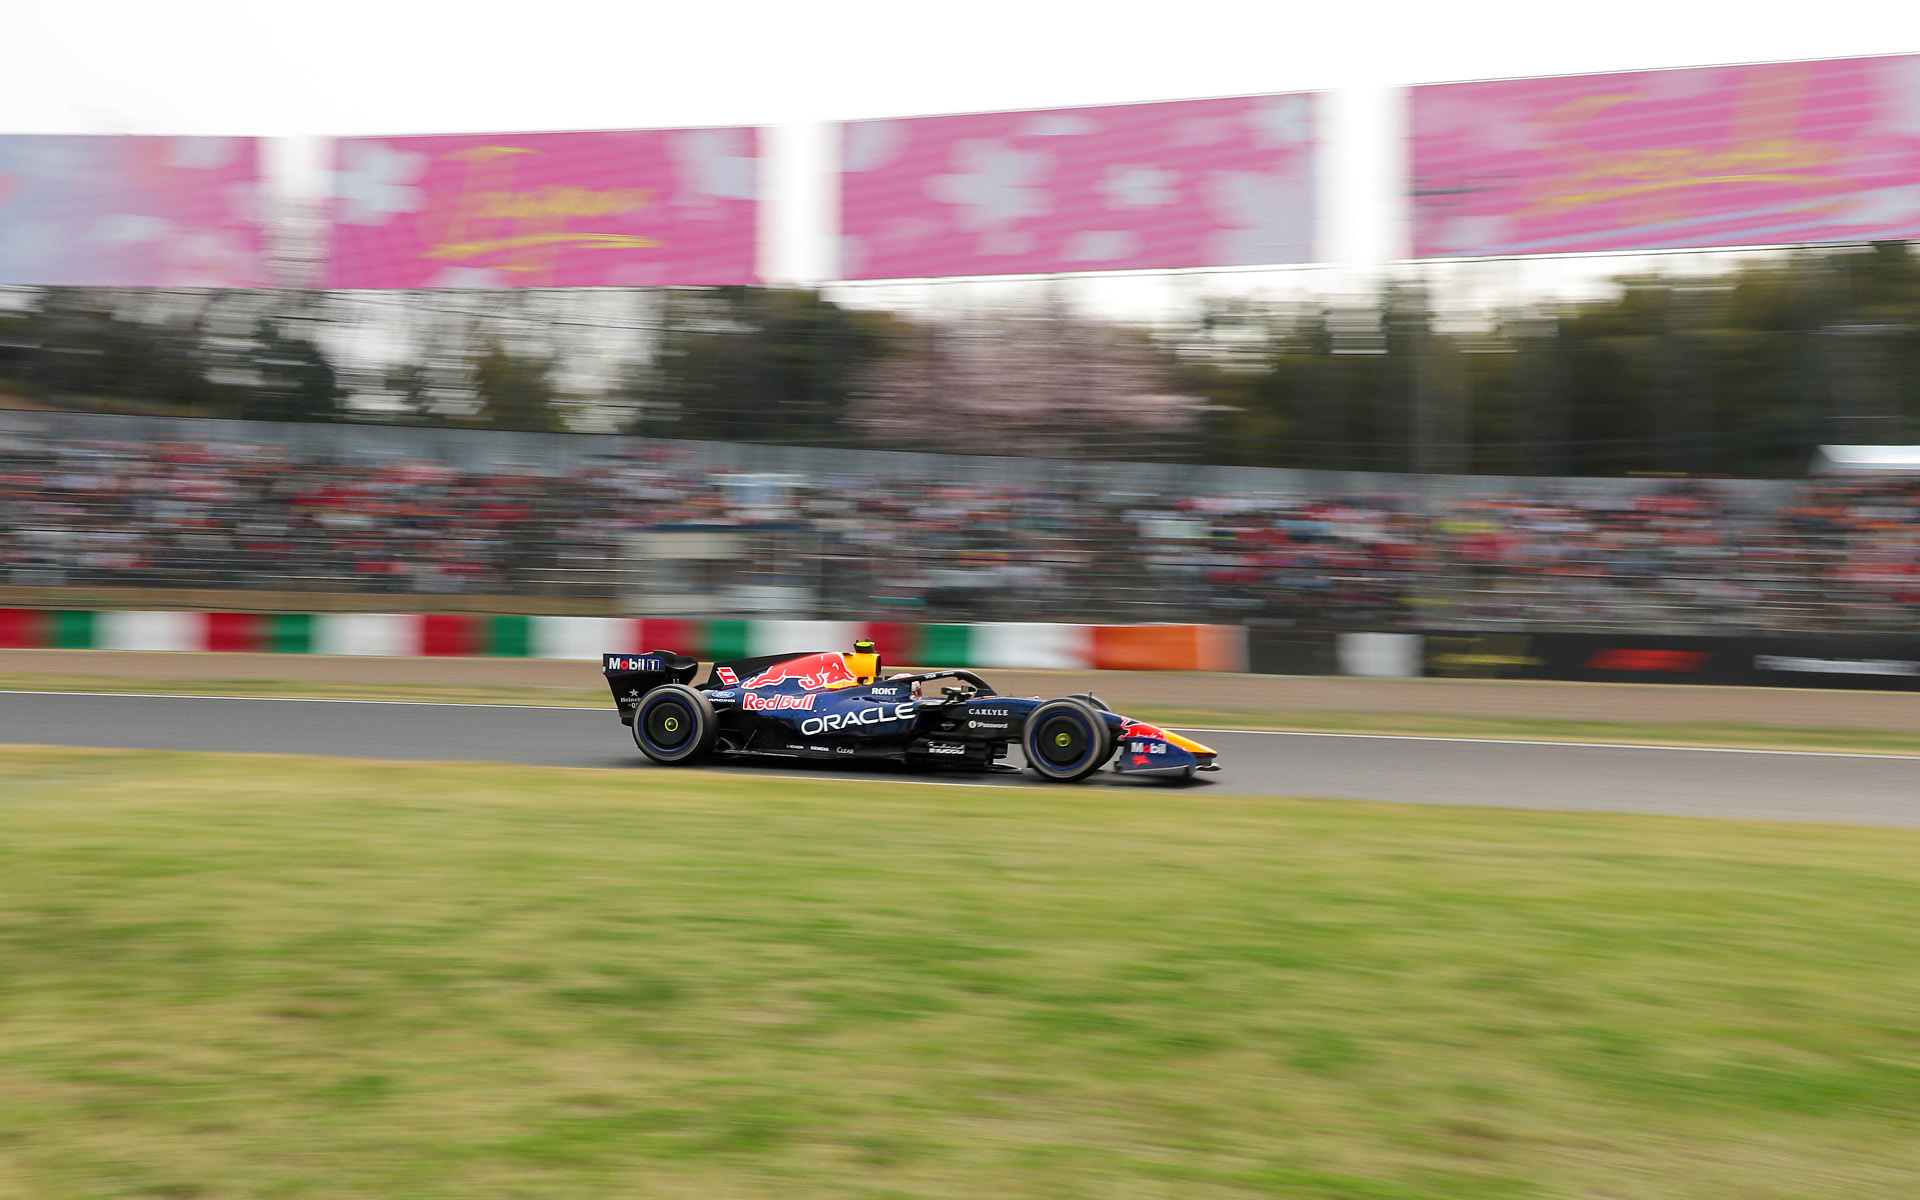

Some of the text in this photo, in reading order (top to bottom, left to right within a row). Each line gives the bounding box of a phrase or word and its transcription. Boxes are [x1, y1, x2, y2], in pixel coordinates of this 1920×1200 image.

[608, 658, 645, 670] Mobil
[872, 688, 898, 696] ROKT
[743, 692, 816, 710] Red Bull
[801, 703, 916, 736] ORACLE
[1130, 742, 1166, 754] Mobil
